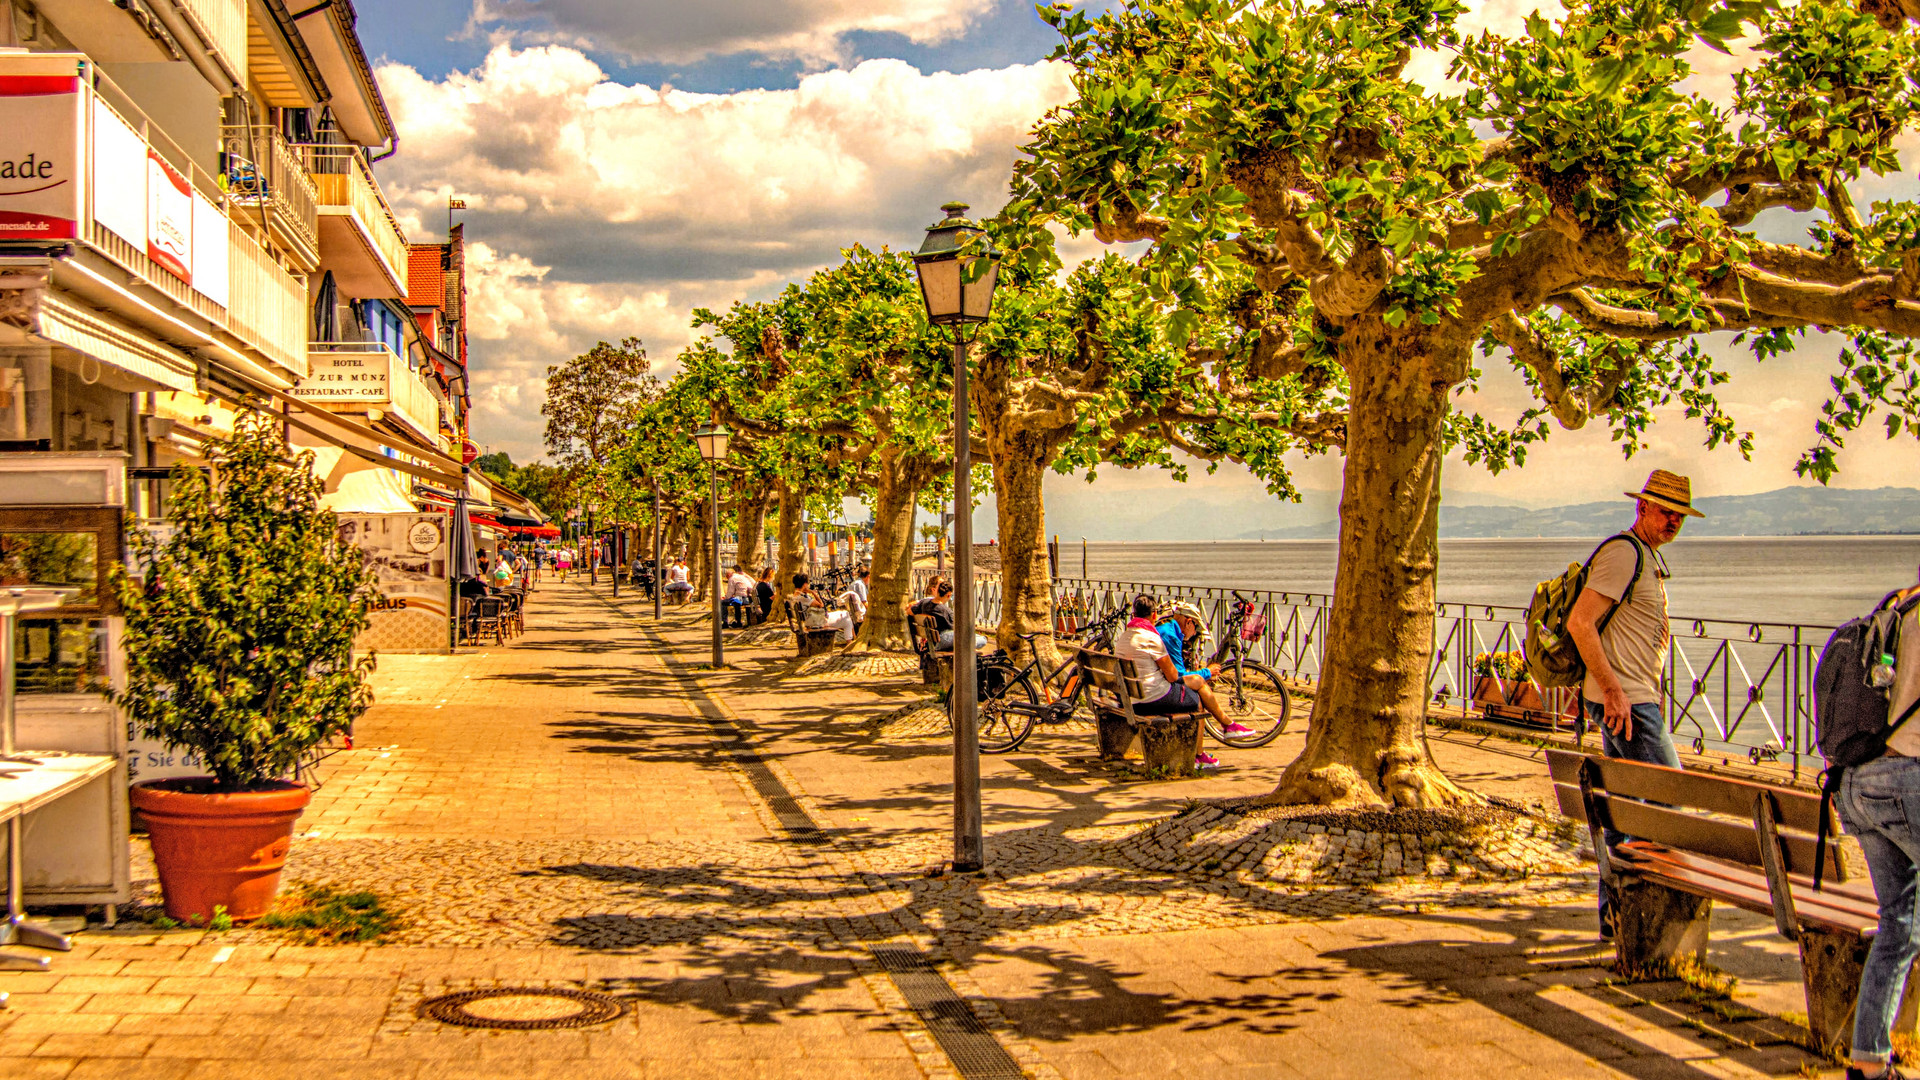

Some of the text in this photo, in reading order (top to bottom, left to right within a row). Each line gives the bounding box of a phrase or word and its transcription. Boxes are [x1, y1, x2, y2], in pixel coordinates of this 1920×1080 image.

[351, 373, 386, 381] MÜNZ
[294, 388, 354, 396] RESTAURANT
[147, 752, 175, 768] Sie
